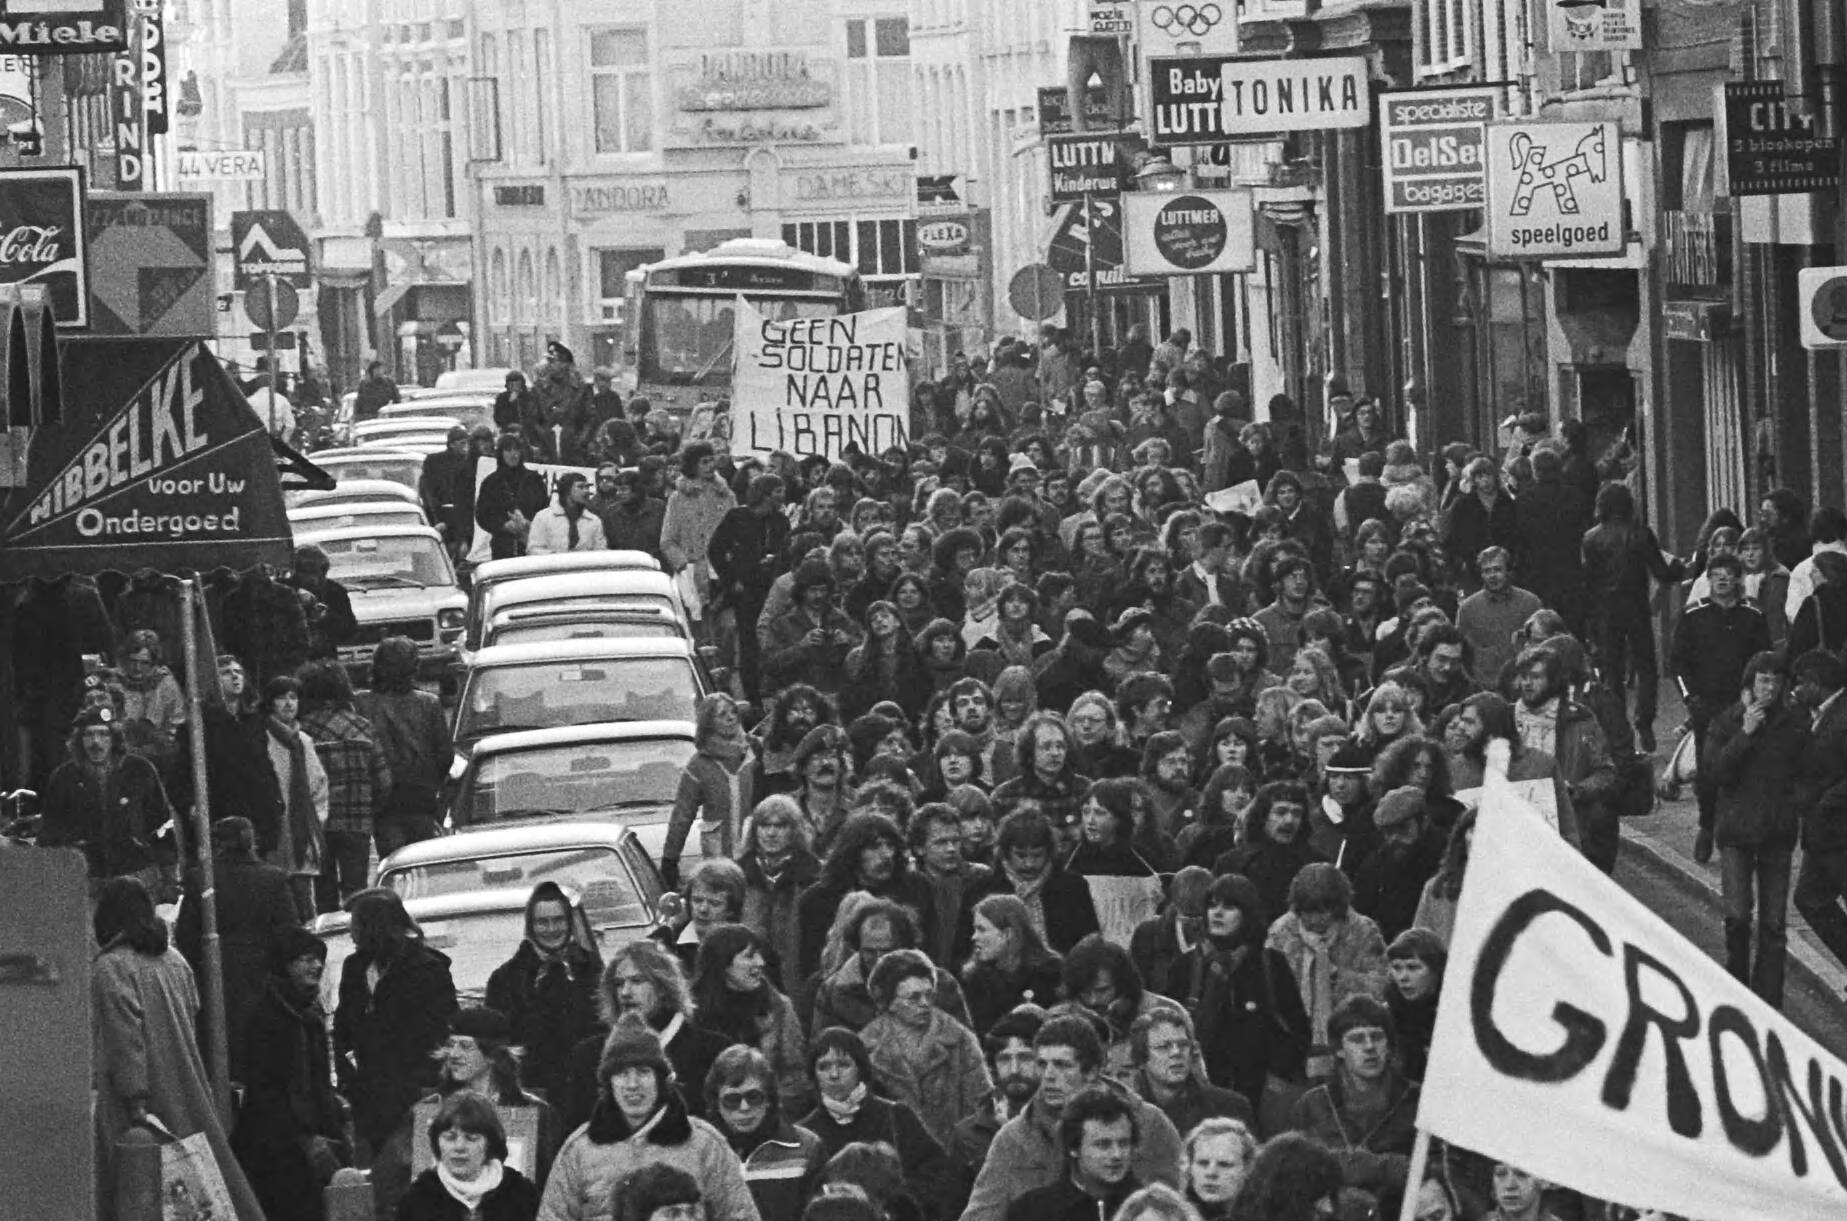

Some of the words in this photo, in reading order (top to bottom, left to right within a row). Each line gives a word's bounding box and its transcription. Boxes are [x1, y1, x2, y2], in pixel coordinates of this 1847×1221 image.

[0, 20, 119, 45] Miele
[1170, 68, 1221, 100] Baby
[1232, 74, 1358, 115] TONIKA
[1395, 100, 1487, 124] specialiste
[205, 157, 260, 175] VERA
[1160, 209, 1219, 225] LUTTMER
[1511, 221, 1609, 248] speelgoed
[761, 314, 857, 346] GEEN
[758, 341, 909, 374] SOLDATEN
[786, 373, 883, 410] NAAR
[30, 340, 209, 525] NIBBELKE
[750, 406, 911, 459] LIBANON
[149, 475, 204, 495] voor
[208, 472, 246, 495] Uw
[75, 505, 241, 538] Ondergoed
